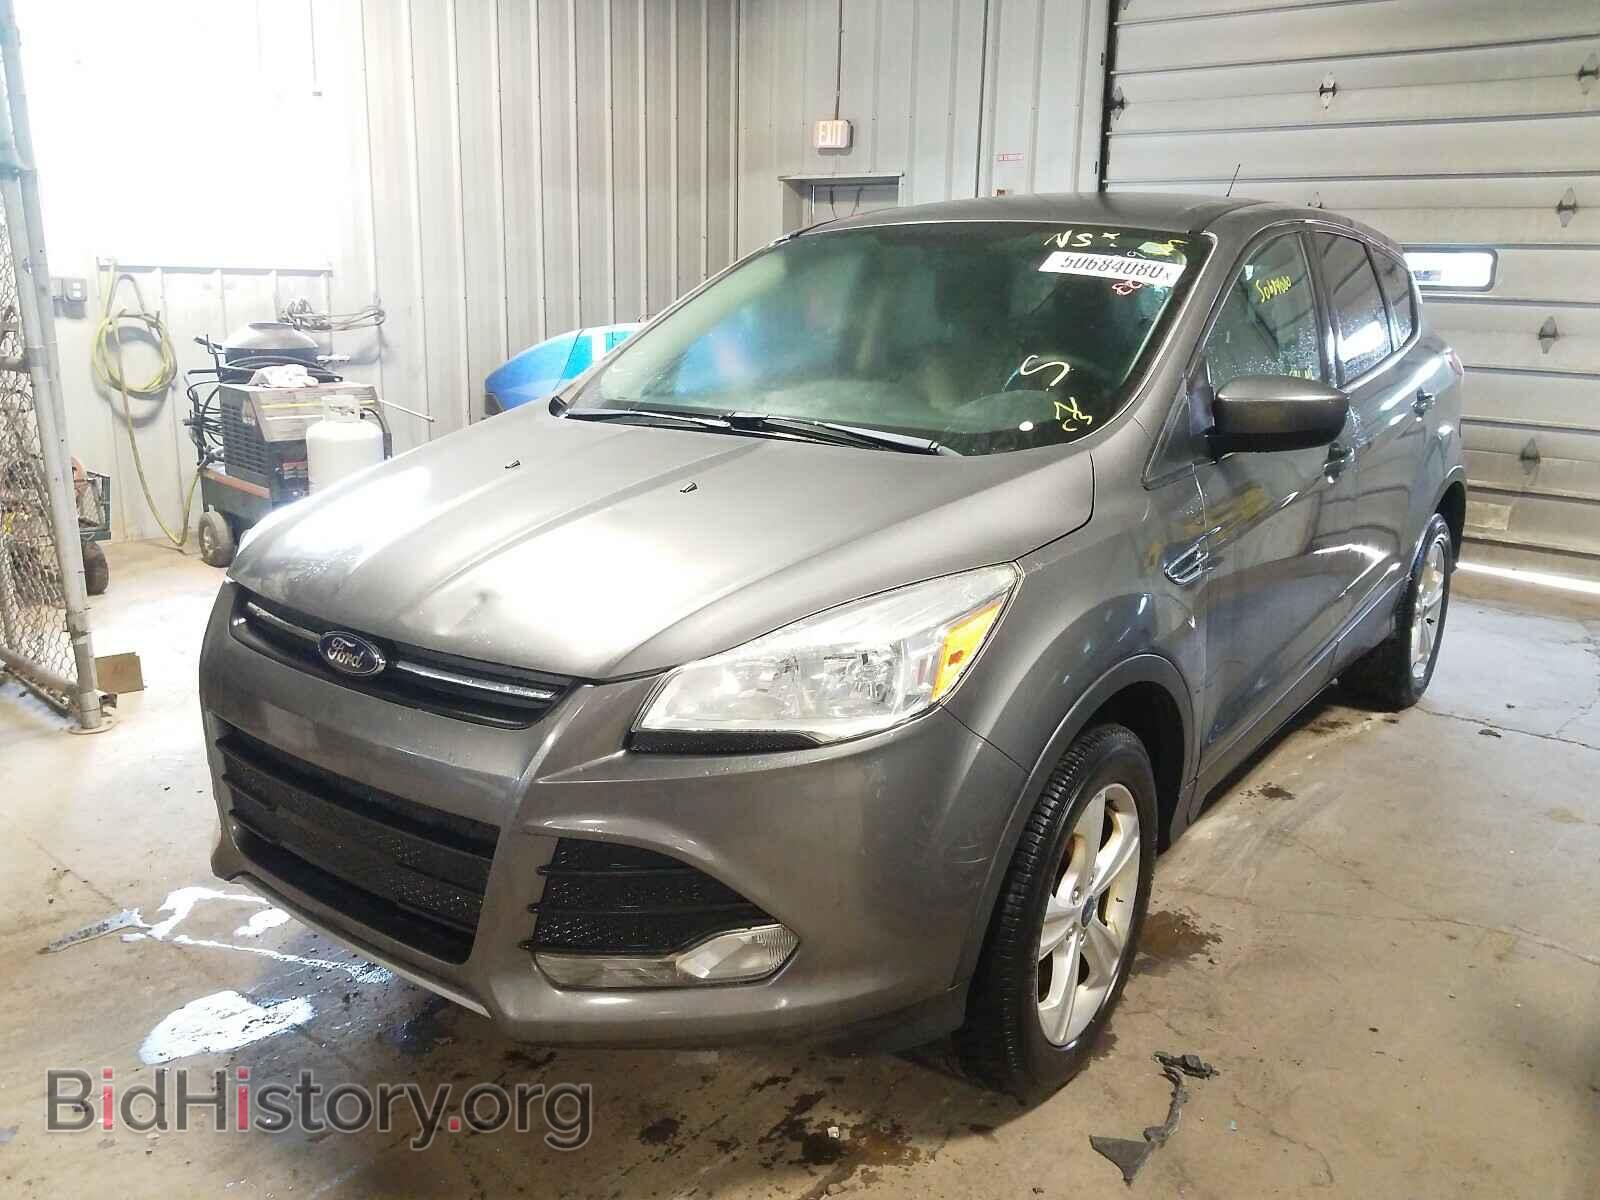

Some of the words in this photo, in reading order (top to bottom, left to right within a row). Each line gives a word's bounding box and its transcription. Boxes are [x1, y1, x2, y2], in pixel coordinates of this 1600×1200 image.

[818, 125, 841, 146] EXIT
[1060, 255, 1166, 279] 50684080
[327, 636, 365, 669] Ford
